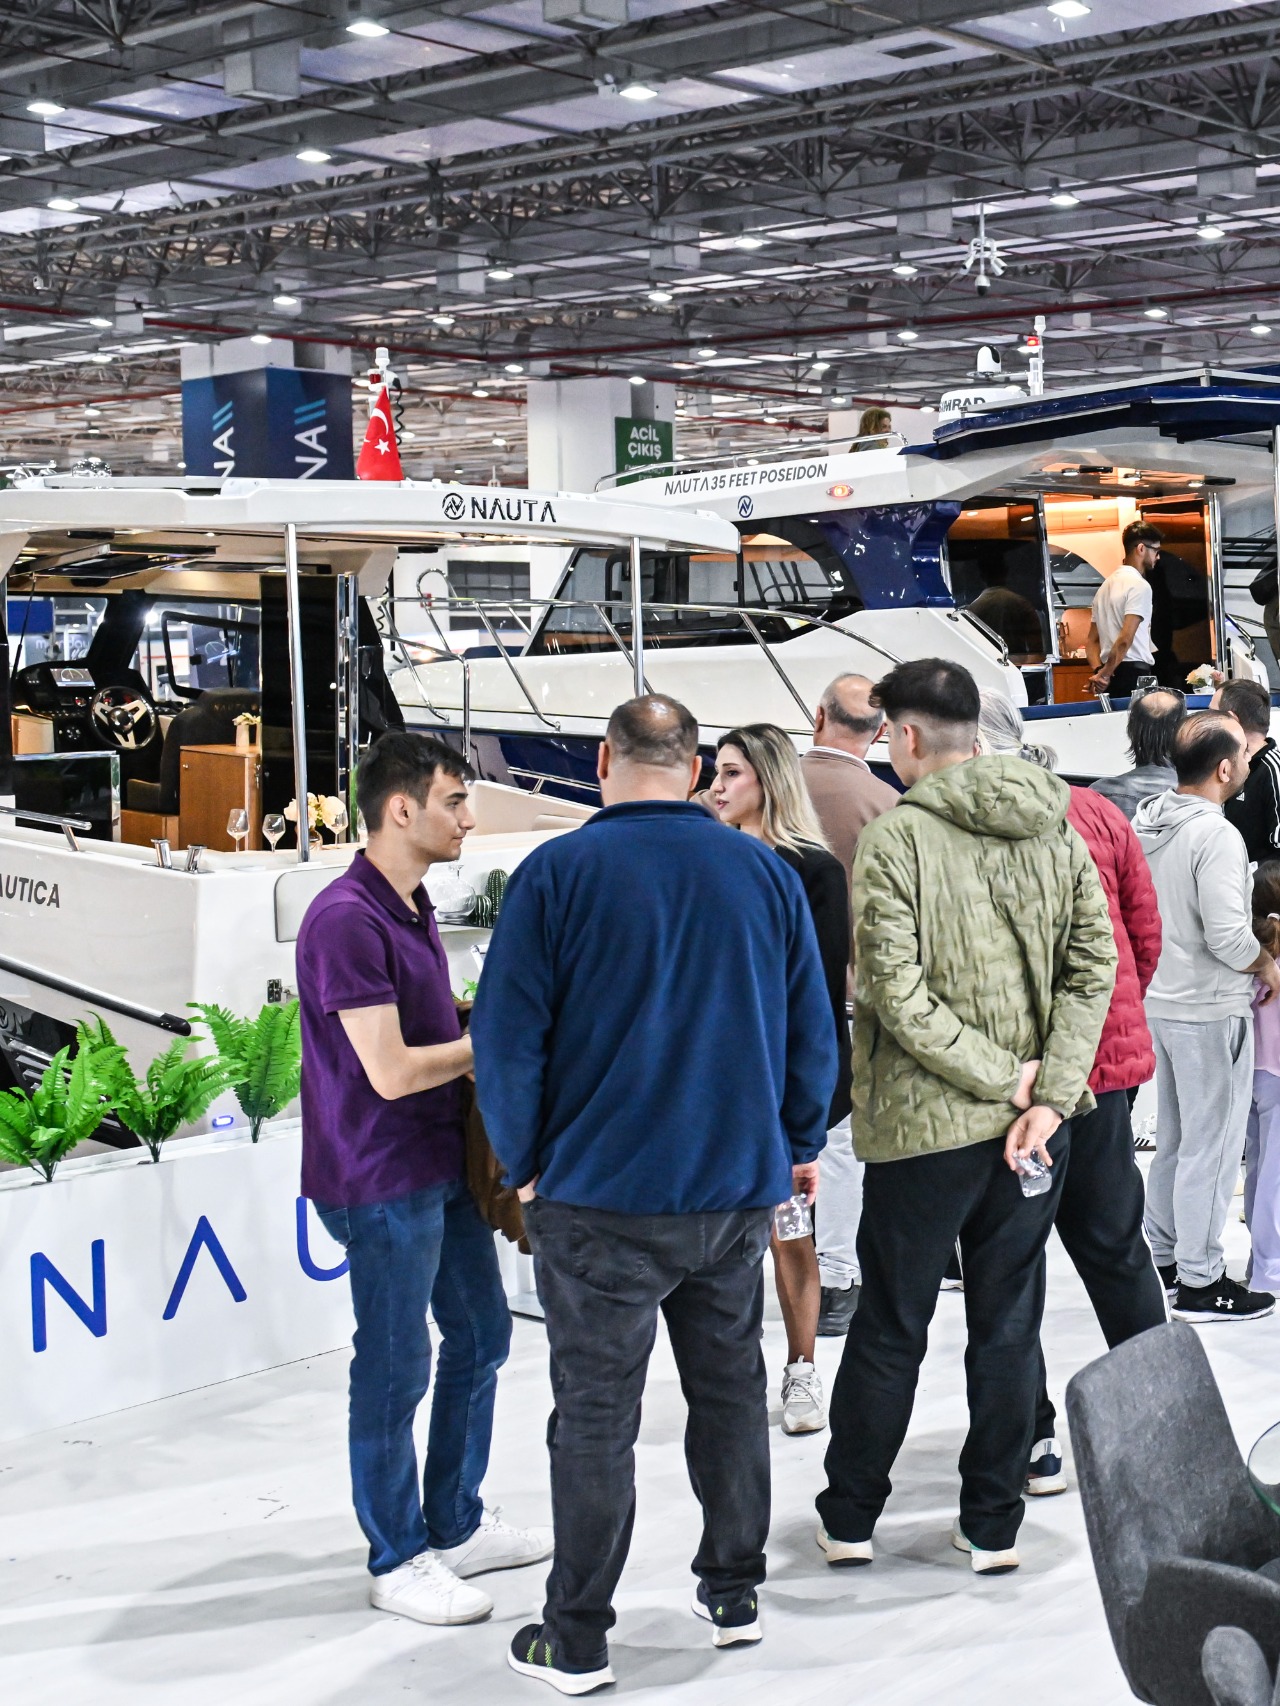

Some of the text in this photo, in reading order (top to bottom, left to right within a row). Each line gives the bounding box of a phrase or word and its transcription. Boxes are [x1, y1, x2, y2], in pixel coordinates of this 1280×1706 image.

[630, 424, 660, 442] ACİL
[627, 442, 662, 460] ÇIKIŞ
[664, 463, 828, 496] NAUTA 35 FEET POSEIDON
[471, 496, 557, 523] NAUTA
[0, 874, 61, 909] UTICA
